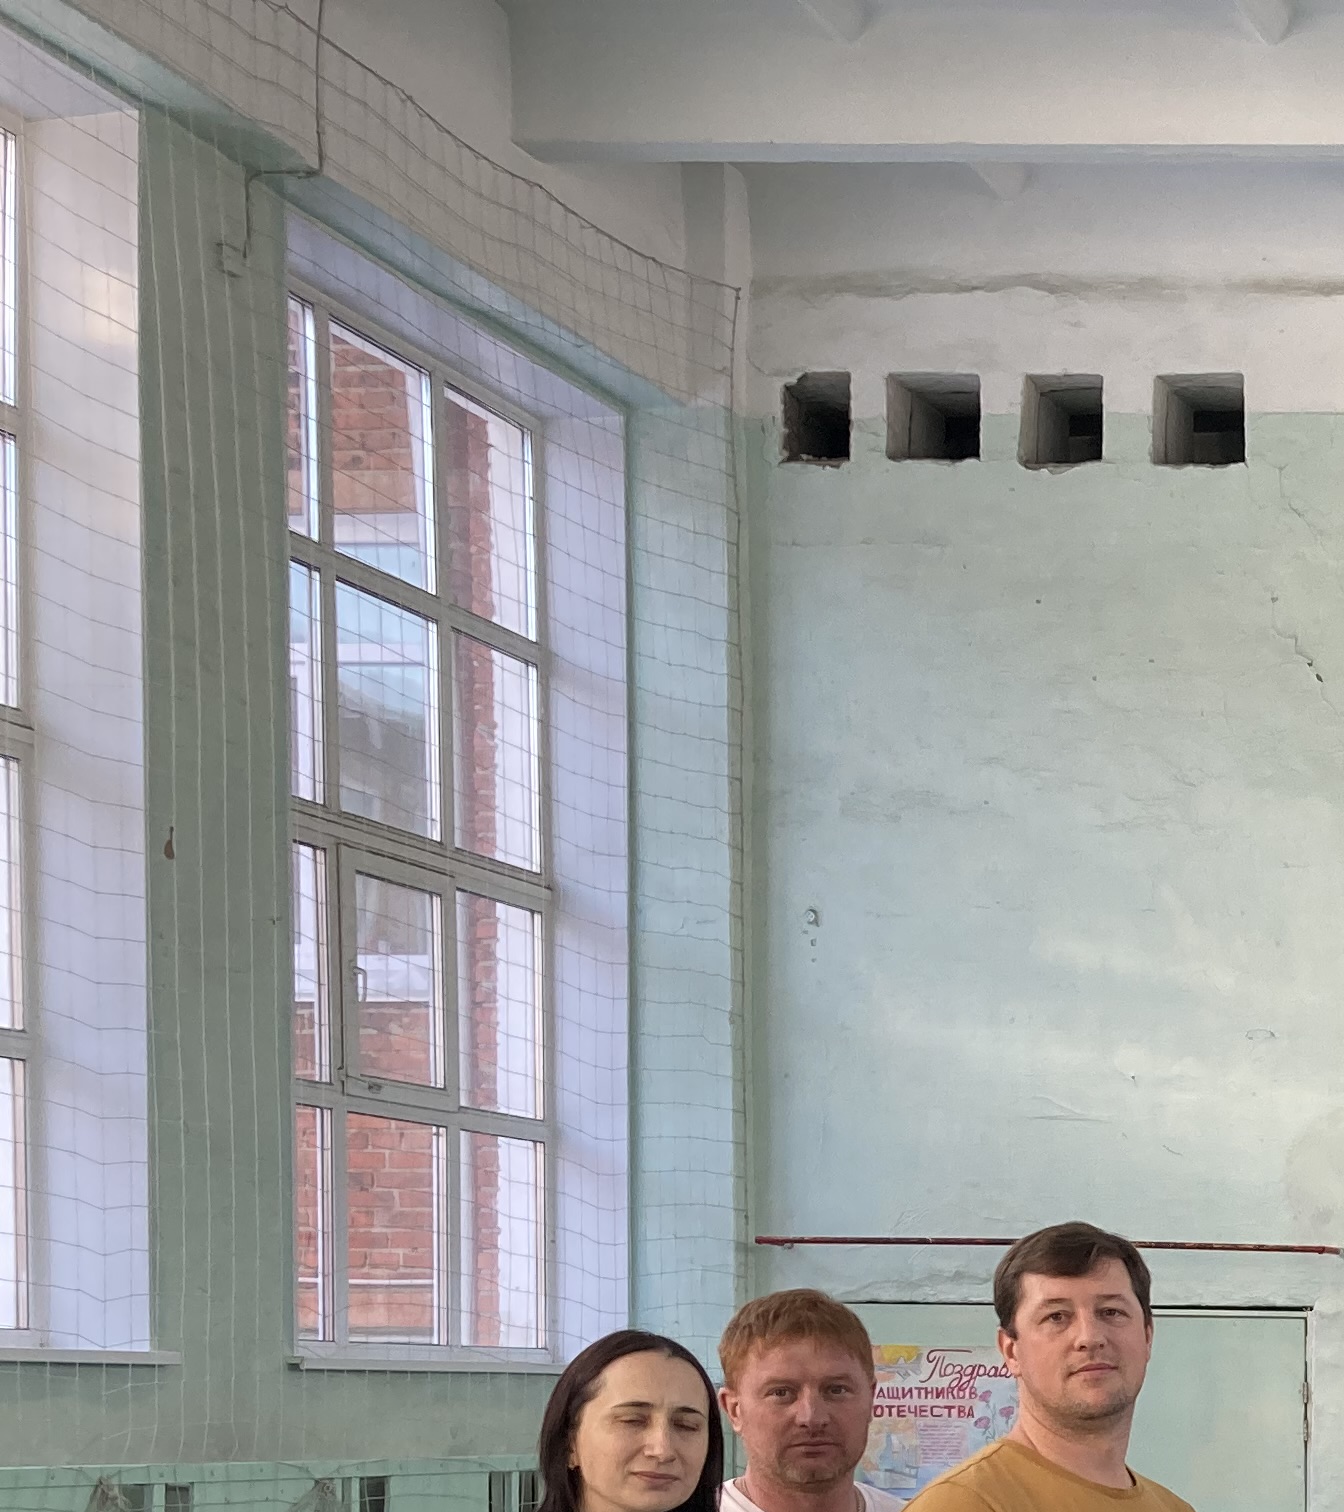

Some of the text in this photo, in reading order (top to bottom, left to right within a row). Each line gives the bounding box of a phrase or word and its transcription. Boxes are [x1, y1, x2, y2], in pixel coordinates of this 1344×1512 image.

[919, 1349, 1014, 1391] Поздрав
[873, 1386, 978, 1400] АЩИТНИКОВ
[873, 1404, 975, 1419] ОТЕЧЕСТВА
